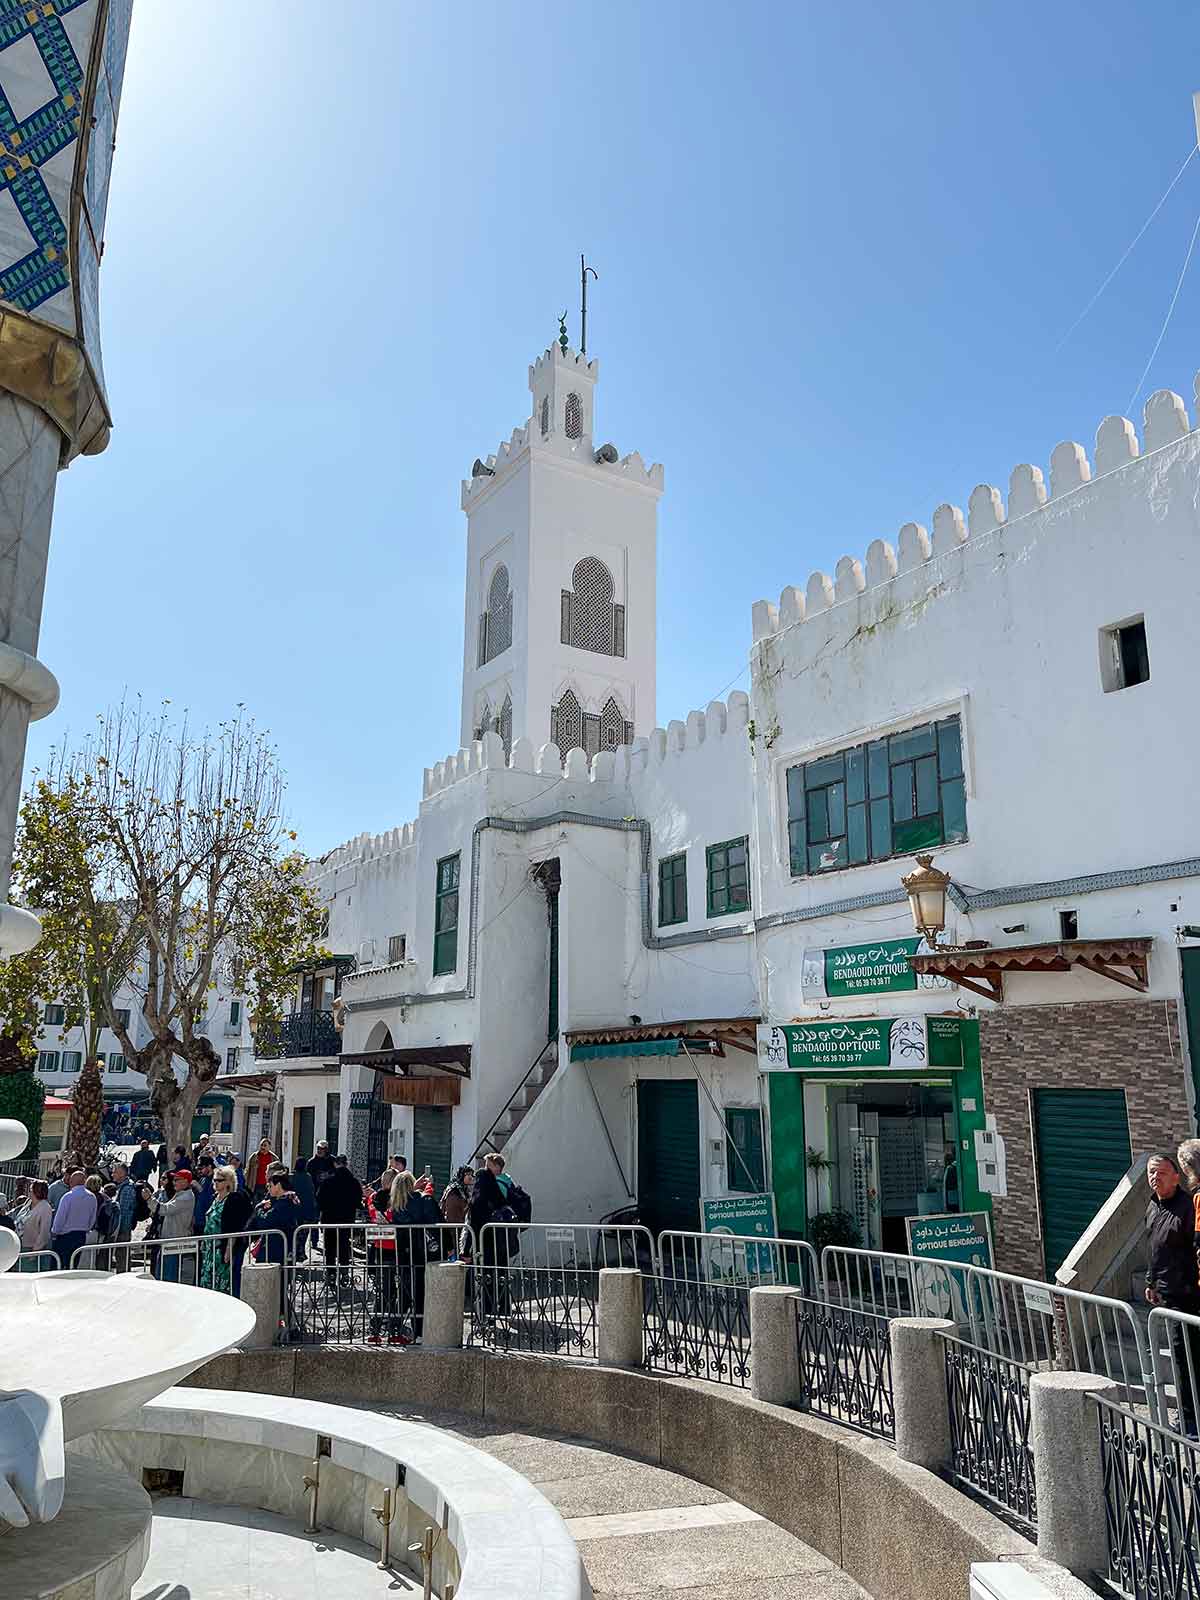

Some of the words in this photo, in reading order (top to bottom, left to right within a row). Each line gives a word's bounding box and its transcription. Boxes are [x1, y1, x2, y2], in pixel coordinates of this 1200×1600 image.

[833, 966, 873, 980] BENDAOUD
[873, 962, 909, 977] OPTIQUE
[870, 978, 877, 986] 70
[884, 976, 891, 985] 77
[792, 1042, 838, 1053] BENDAOUD
[839, 1040, 881, 1053] OPTIQUE
[831, 1054, 838, 1062] 39
[838, 1054, 846, 1062] 70
[855, 1053, 862, 1061] 77
[708, 1212, 735, 1220] OPTIQUE
[916, 1226, 933, 1239] داود
[916, 1240, 948, 1251] OPTIQUE
[948, 1236, 985, 1248] BENDAOUD
